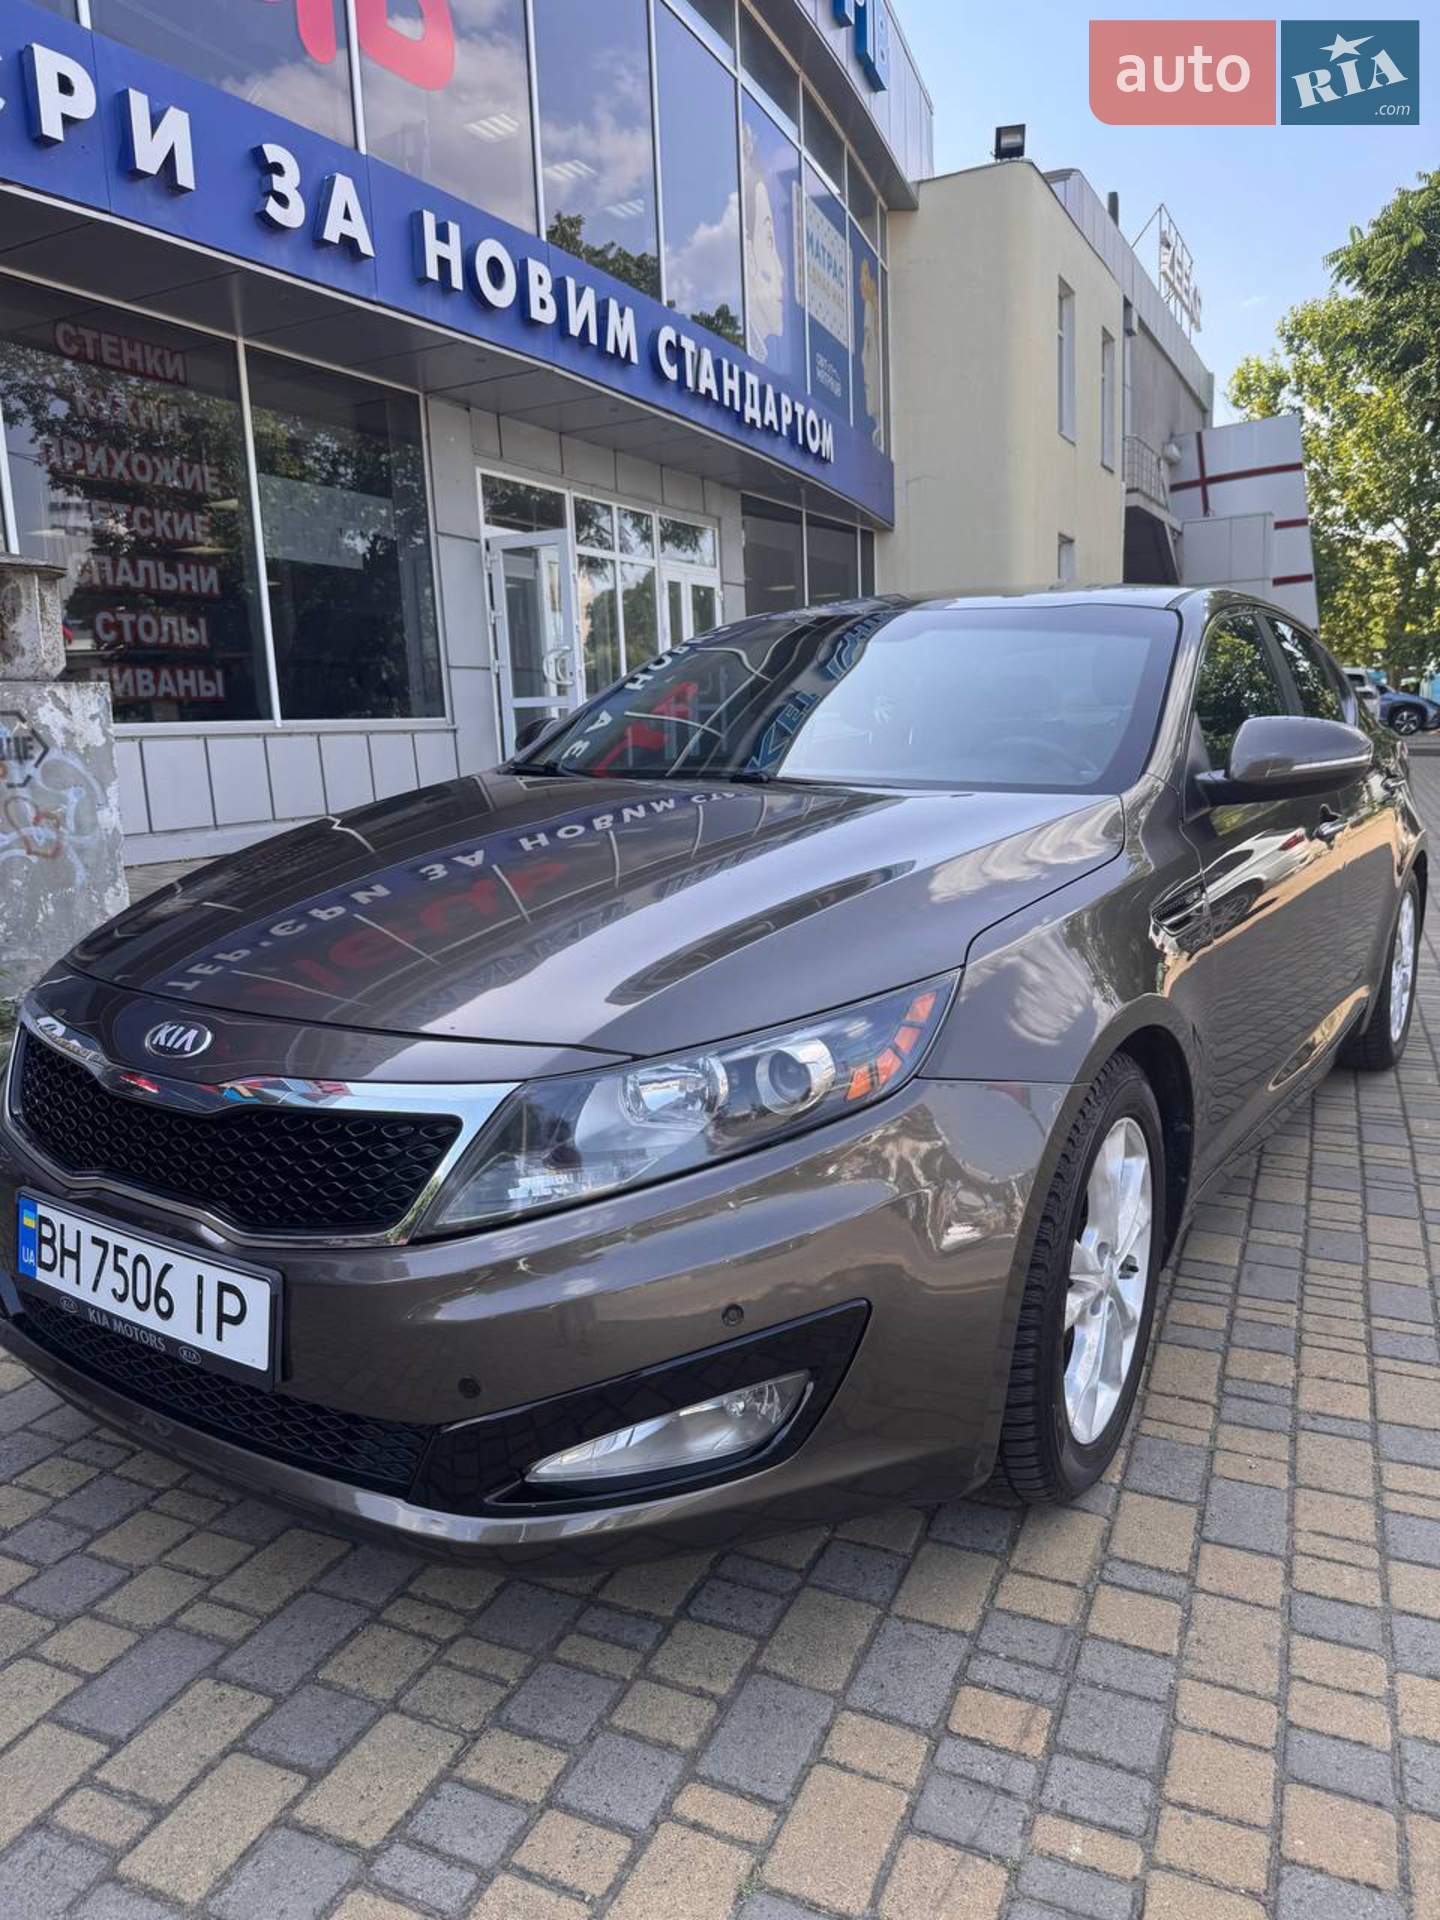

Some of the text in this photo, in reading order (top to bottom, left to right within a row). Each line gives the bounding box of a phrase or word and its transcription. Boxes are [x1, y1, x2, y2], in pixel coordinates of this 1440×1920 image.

[0, 42, 196, 192] РИ
[258, 142, 376, 258] ЗА
[416, 207, 639, 366] НОВИМ
[656, 324, 835, 464] СТАНДАРТОМ
[55, 321, 186, 385] СТЕНКИ
[89, 500, 213, 545] ЕТСКИЕ
[95, 611, 210, 648] СТОЛЫ
[152, 1024, 199, 1052] KIA
[21, 1247, 34, 1267] UA
[38, 1214, 247, 1342] BH 7506 IP
[89, 1308, 166, 1352] KIA MOTORS
